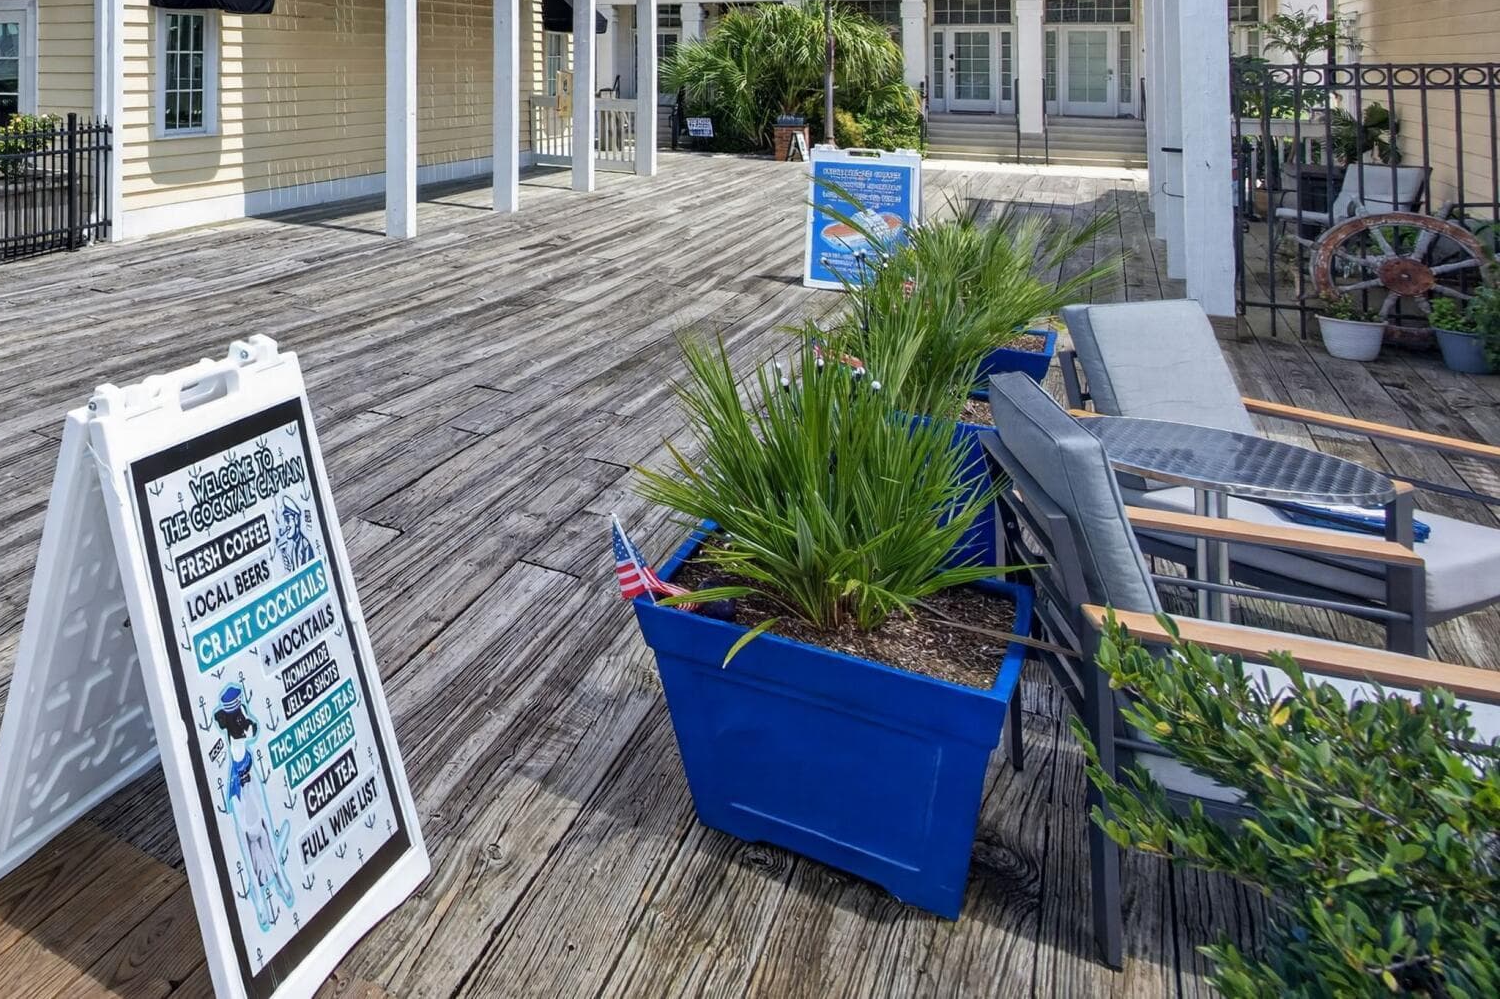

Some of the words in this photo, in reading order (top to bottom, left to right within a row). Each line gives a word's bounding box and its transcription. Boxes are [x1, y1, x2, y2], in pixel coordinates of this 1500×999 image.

[160, 510, 191, 546] THE
[191, 482, 257, 532] COCKTAIL
[257, 456, 305, 499] CAPTAIN
[189, 456, 256, 503] WELCOME
[256, 448, 273, 472] TO
[179, 544, 222, 584] FRESH
[225, 519, 270, 559] COFFEE
[187, 584, 234, 622] LOCAL
[234, 559, 270, 596] BEERS
[199, 614, 252, 665] CRAFT
[256, 566, 326, 631] COCKTAILS
[264, 654, 272, 666] +
[272, 604, 335, 664] MOCKTAILS
[284, 645, 328, 689] HOMEMADE
[286, 685, 313, 717] JELL-O
[314, 664, 338, 695] SHOTS
[271, 734, 294, 764] THC
[293, 705, 332, 745] INFUSED
[333, 684, 356, 713] TEAS
[291, 754, 312, 785] AND
[312, 716, 353, 762] SELTZERS
[307, 778, 337, 813] CHAI
[336, 758, 357, 785] TEA
[301, 825, 329, 865] FULL
[329, 797, 359, 837] WINE
[357, 776, 379, 812] LIST
